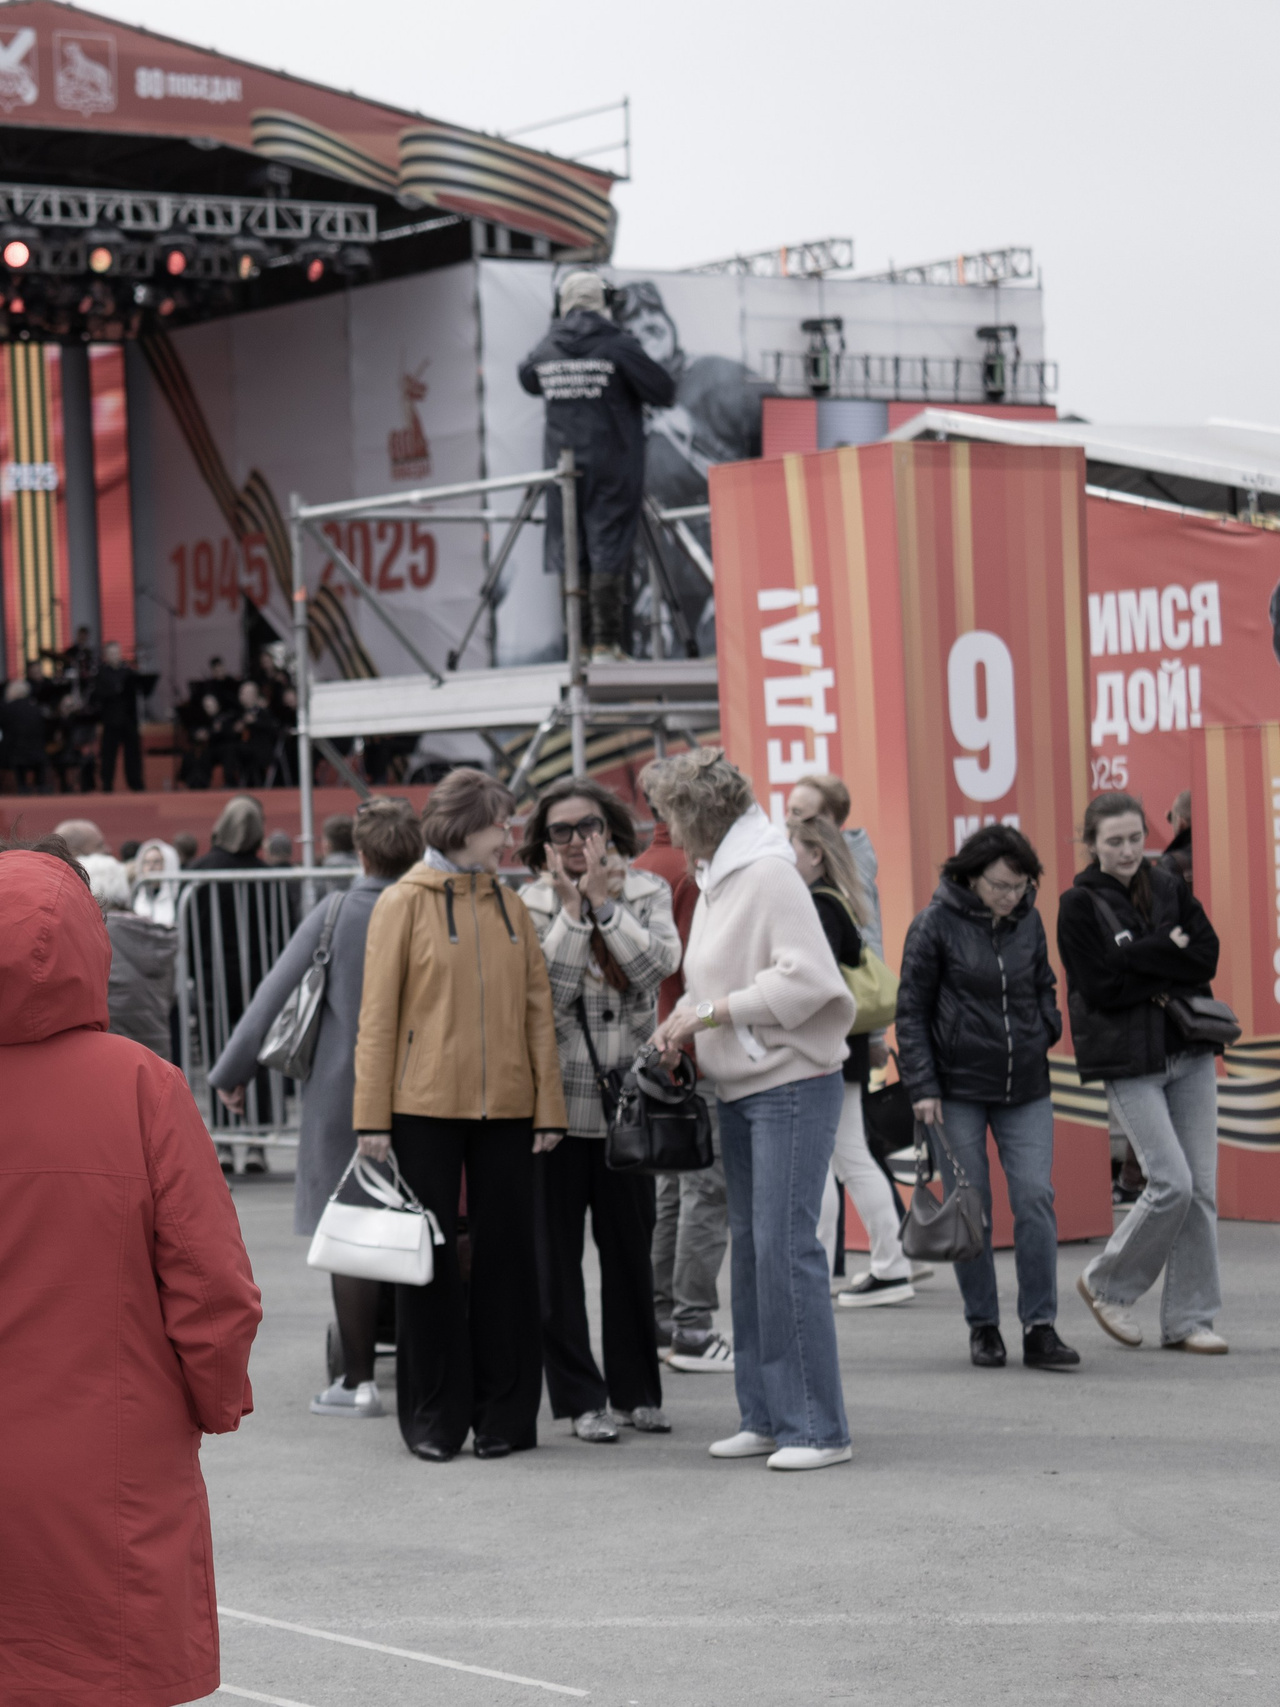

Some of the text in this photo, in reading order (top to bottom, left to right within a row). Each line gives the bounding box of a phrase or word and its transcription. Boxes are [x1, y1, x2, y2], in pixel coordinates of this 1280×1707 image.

[170, 531, 269, 619] 1945
[1088, 580, 1222, 657] ИМСЯ
[947, 630, 1017, 802] 9
[1091, 658, 1202, 747] ДОЙ!
